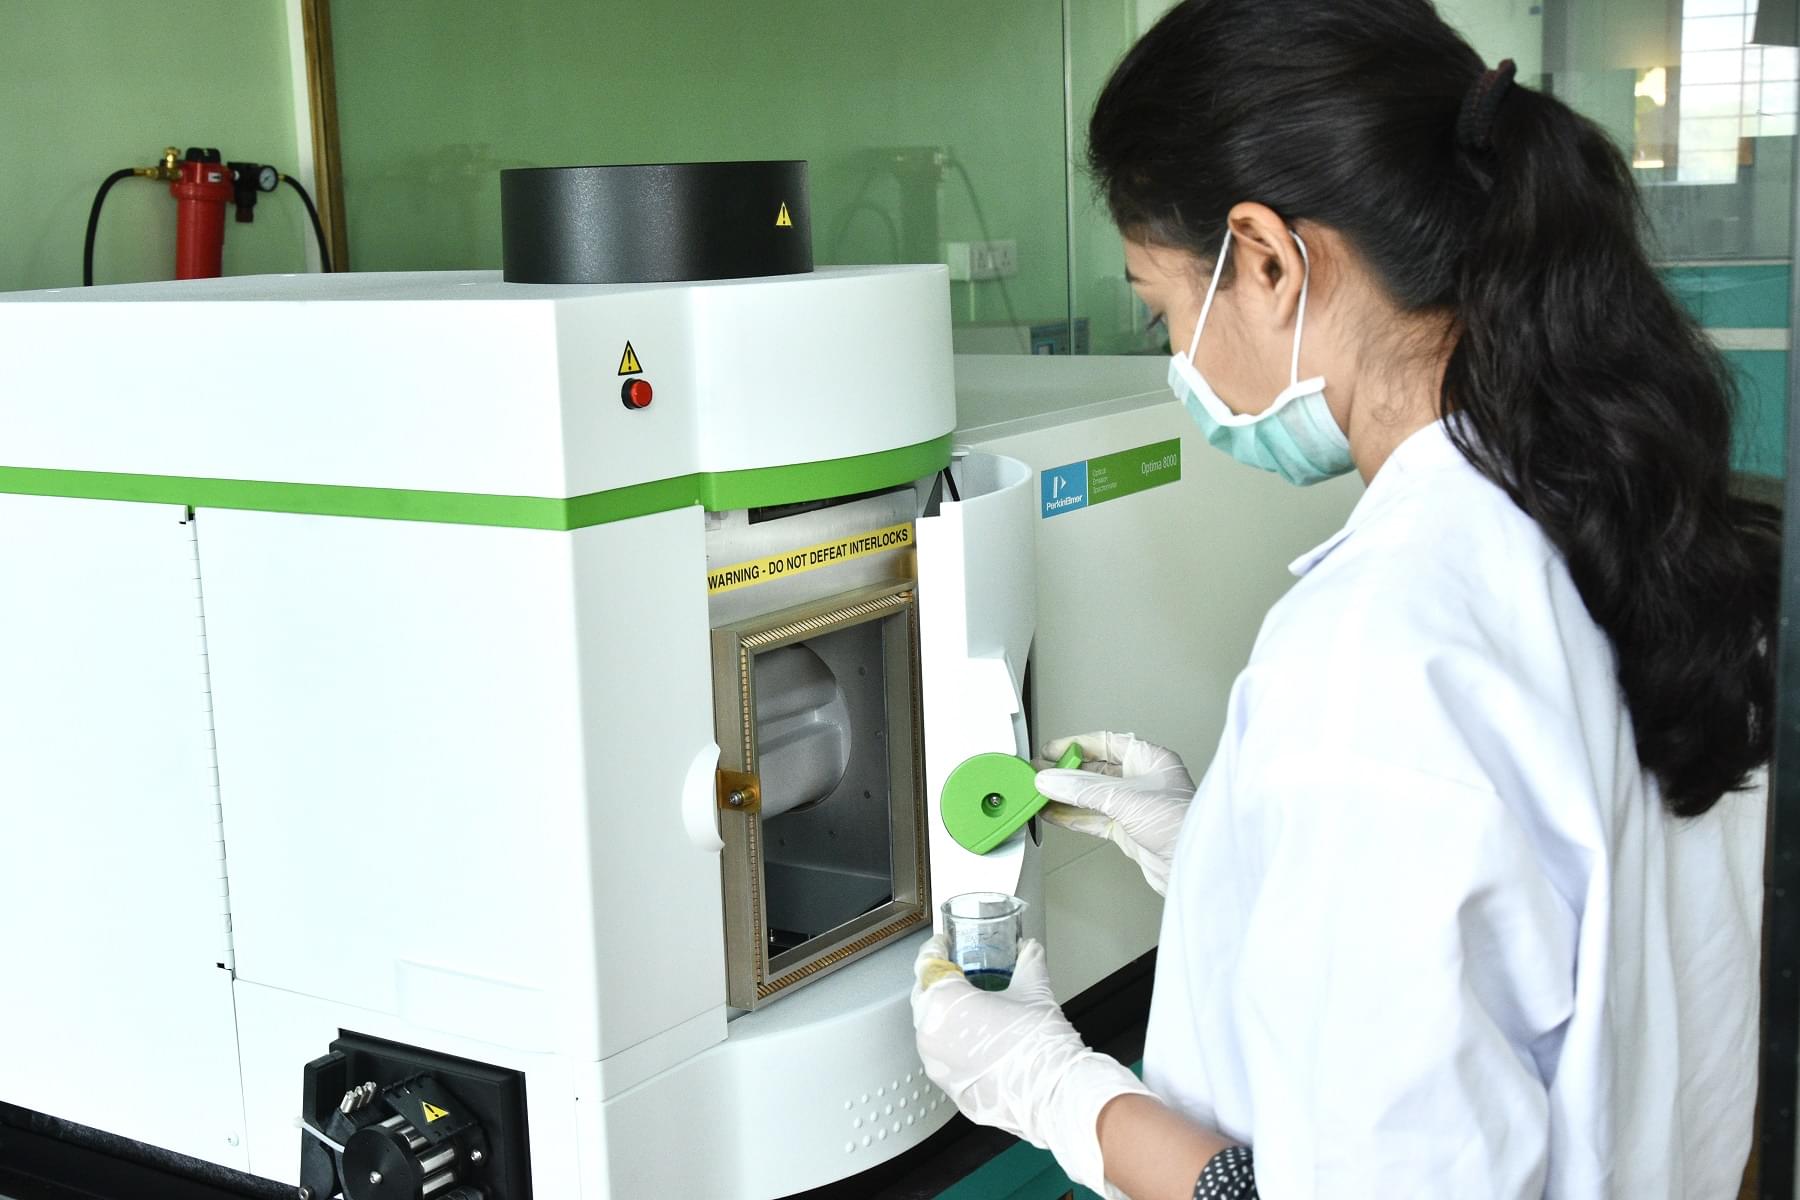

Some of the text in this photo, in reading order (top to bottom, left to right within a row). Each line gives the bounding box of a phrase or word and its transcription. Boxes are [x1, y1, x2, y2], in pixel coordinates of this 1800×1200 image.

[1141, 454, 1177, 476] Optima 8000
[708, 565, 759, 590] WARNING
[768, 559, 784, 575] DO
[786, 554, 807, 571] NOT
[810, 544, 847, 565] DEFEAT
[849, 528, 908, 555] INTERLOCKS
